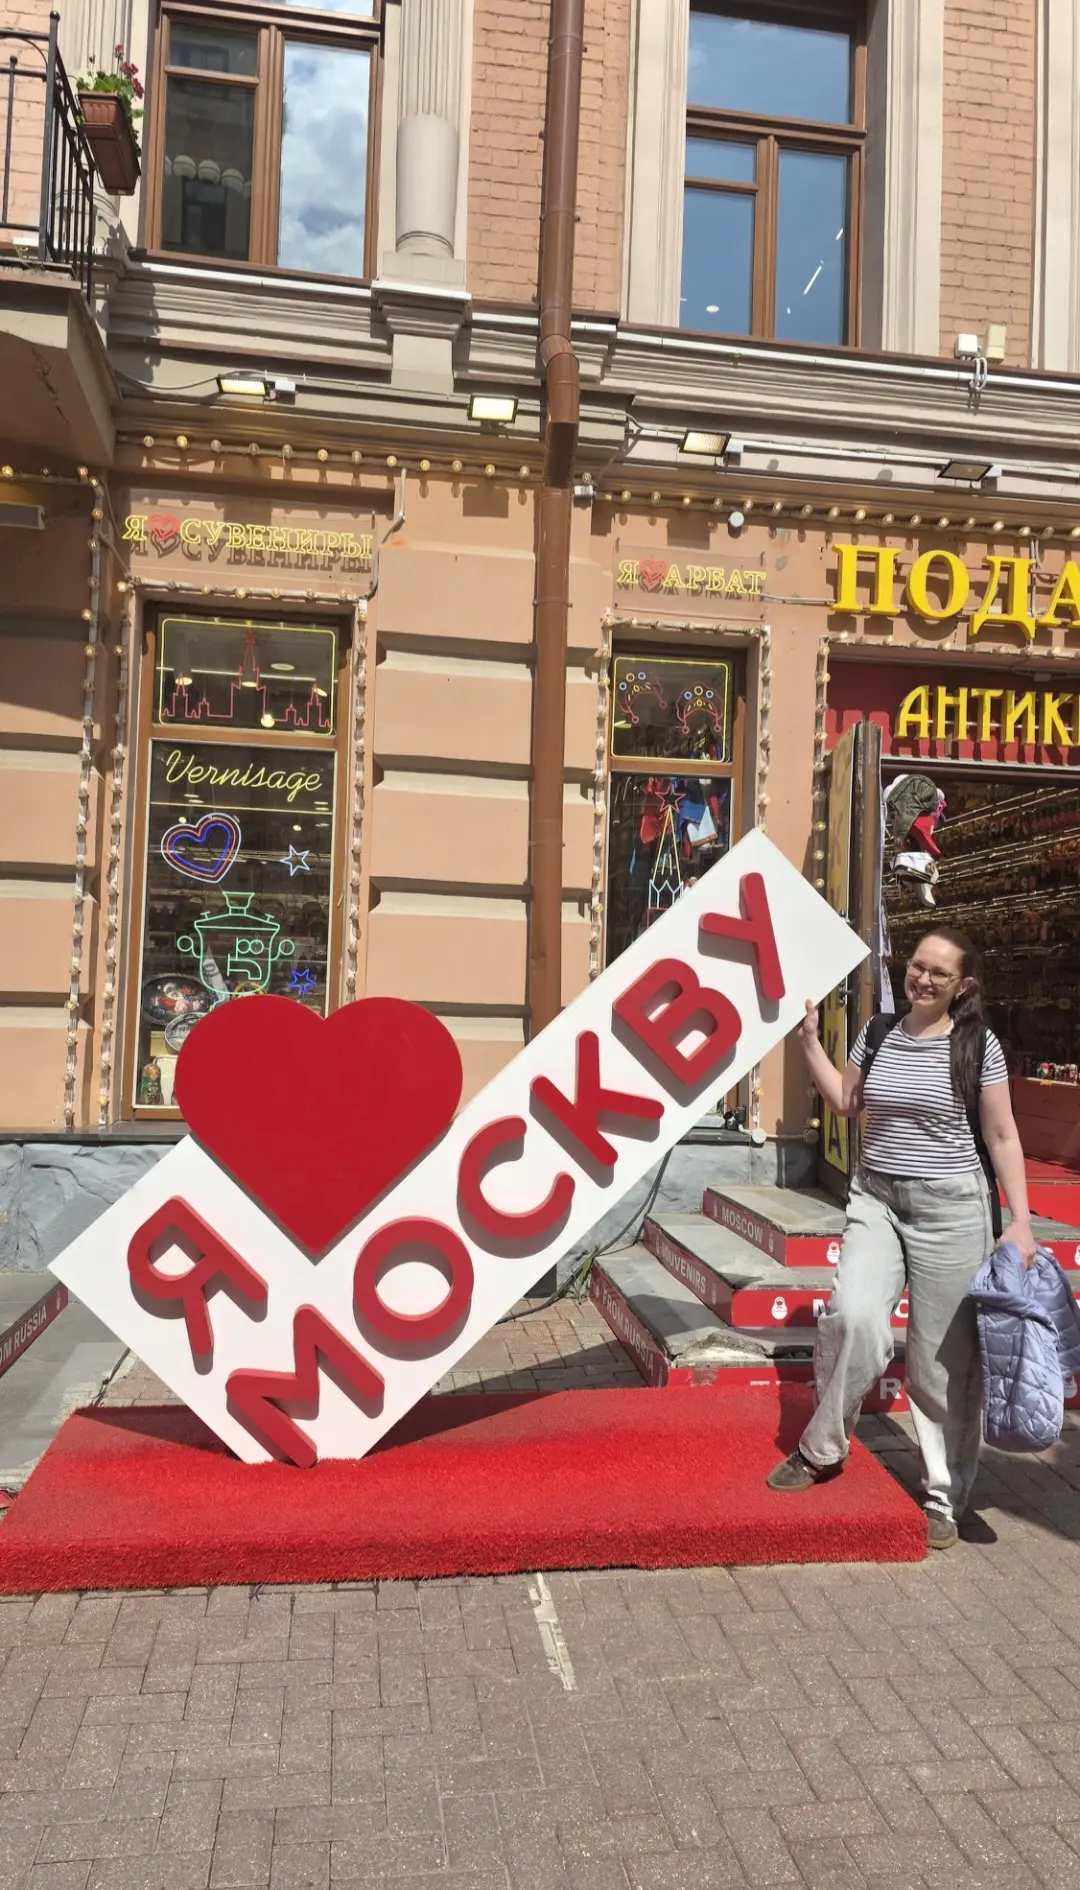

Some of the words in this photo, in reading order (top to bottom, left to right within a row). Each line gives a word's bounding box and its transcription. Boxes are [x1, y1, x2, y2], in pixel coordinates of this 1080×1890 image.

[122, 515, 149, 541] Я
[179, 518, 373, 559] СУВЕНИРЫ
[617, 560, 639, 585] Я
[663, 564, 766, 595] АРБАТ
[895, 684, 1080, 747] АНТИК
[166, 750, 323, 803] Vernisage
[226, 871, 786, 1468] МОСКВУ
[722, 1206, 763, 1244] MOSCOW
[127, 1195, 268, 1357] Я
[14, 1304, 47, 1351] RUSSIA
[603, 1287, 624, 1329] FROM
[624, 1318, 654, 1376] RUSSIA
